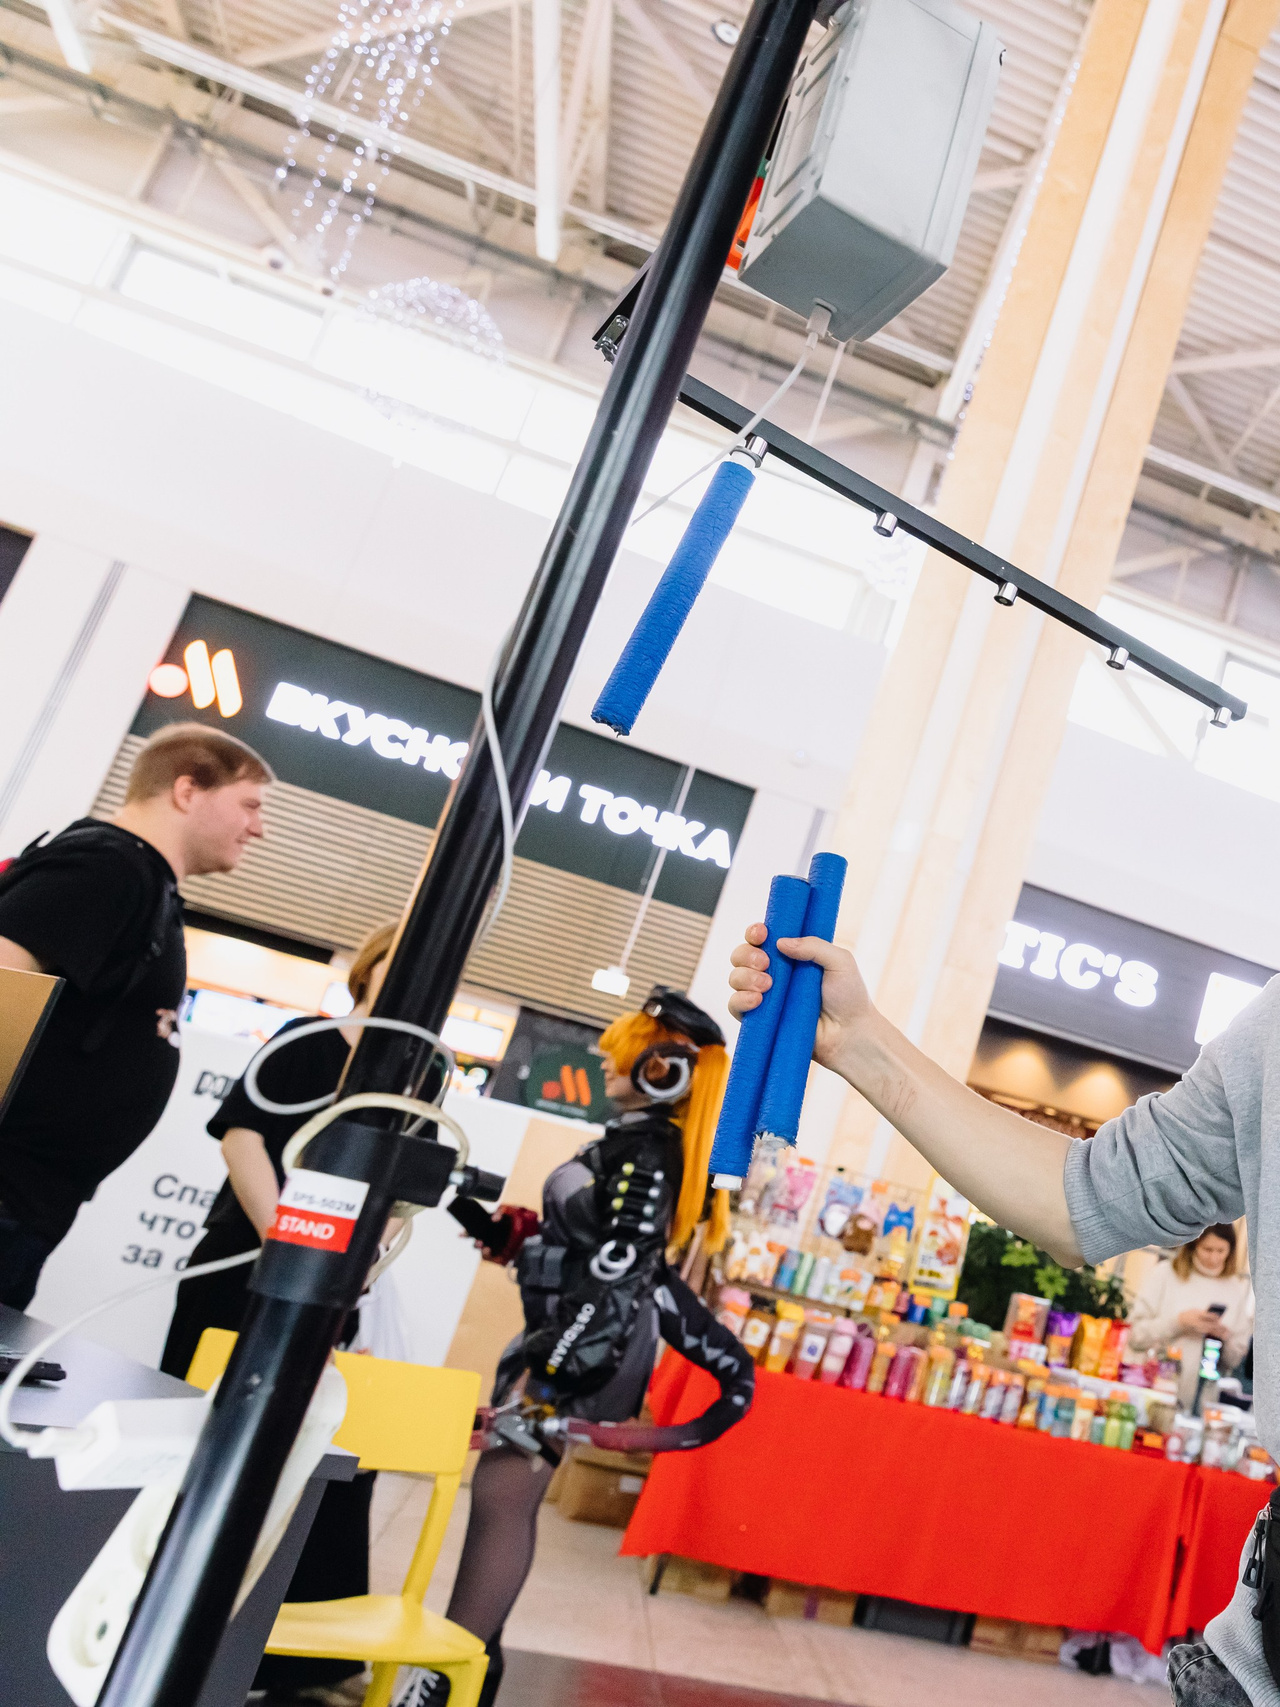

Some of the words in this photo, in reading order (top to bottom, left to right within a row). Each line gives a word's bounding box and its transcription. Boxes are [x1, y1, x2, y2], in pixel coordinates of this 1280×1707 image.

[530, 769, 572, 813] И
[578, 783, 731, 869] ТОЧКА
[277, 1214, 336, 1240] STAND
[120, 1244, 164, 1269] за
